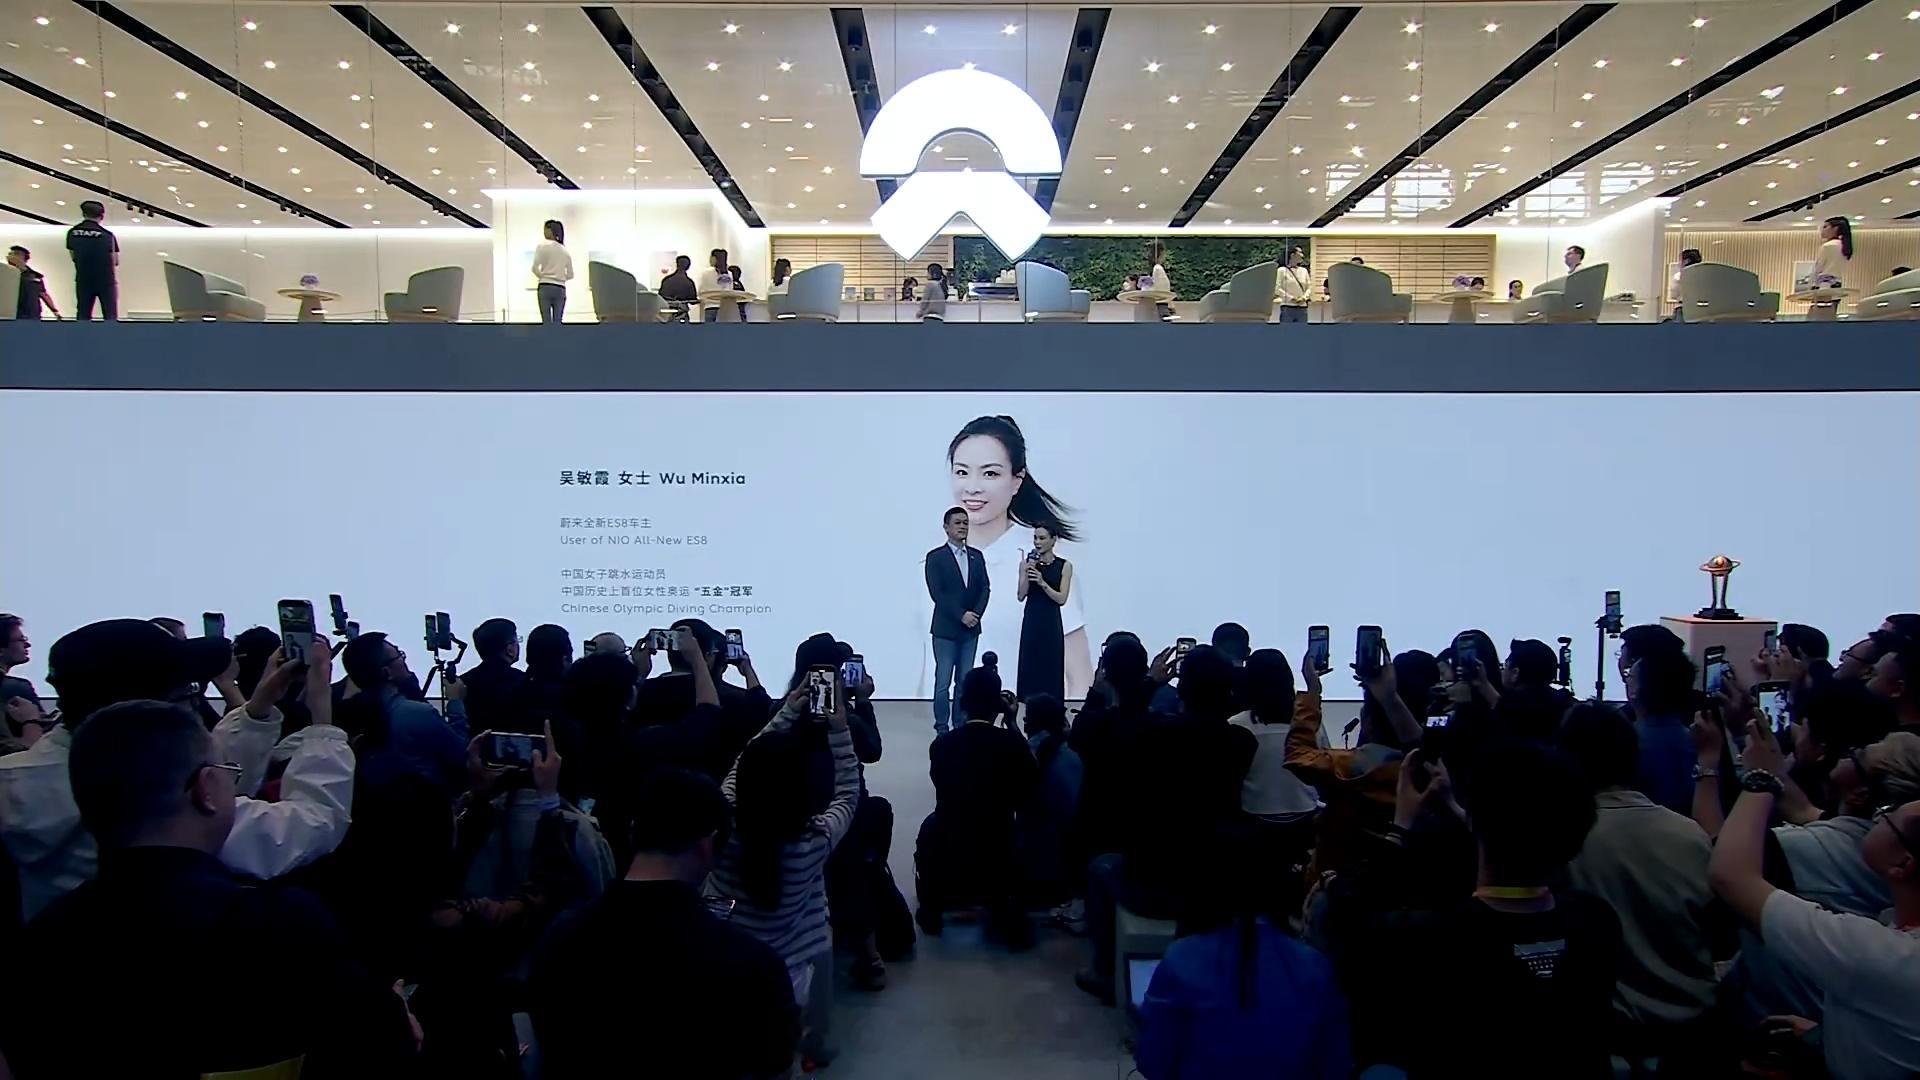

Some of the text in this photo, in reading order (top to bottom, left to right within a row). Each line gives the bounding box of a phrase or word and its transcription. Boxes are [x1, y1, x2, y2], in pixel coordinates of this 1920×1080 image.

[72, 229, 102, 237] STAFF
[560, 470, 746, 486] 吴敏霞 女士 Wu Minxia
[560, 517, 652, 529] 蔚来全新ES8车主
[560, 535, 708, 545] User of NIO All-New ES8
[561, 568, 666, 580] 中国女子跳水运动员
[561, 603, 772, 615] Chinese Olympic Diving Champion
